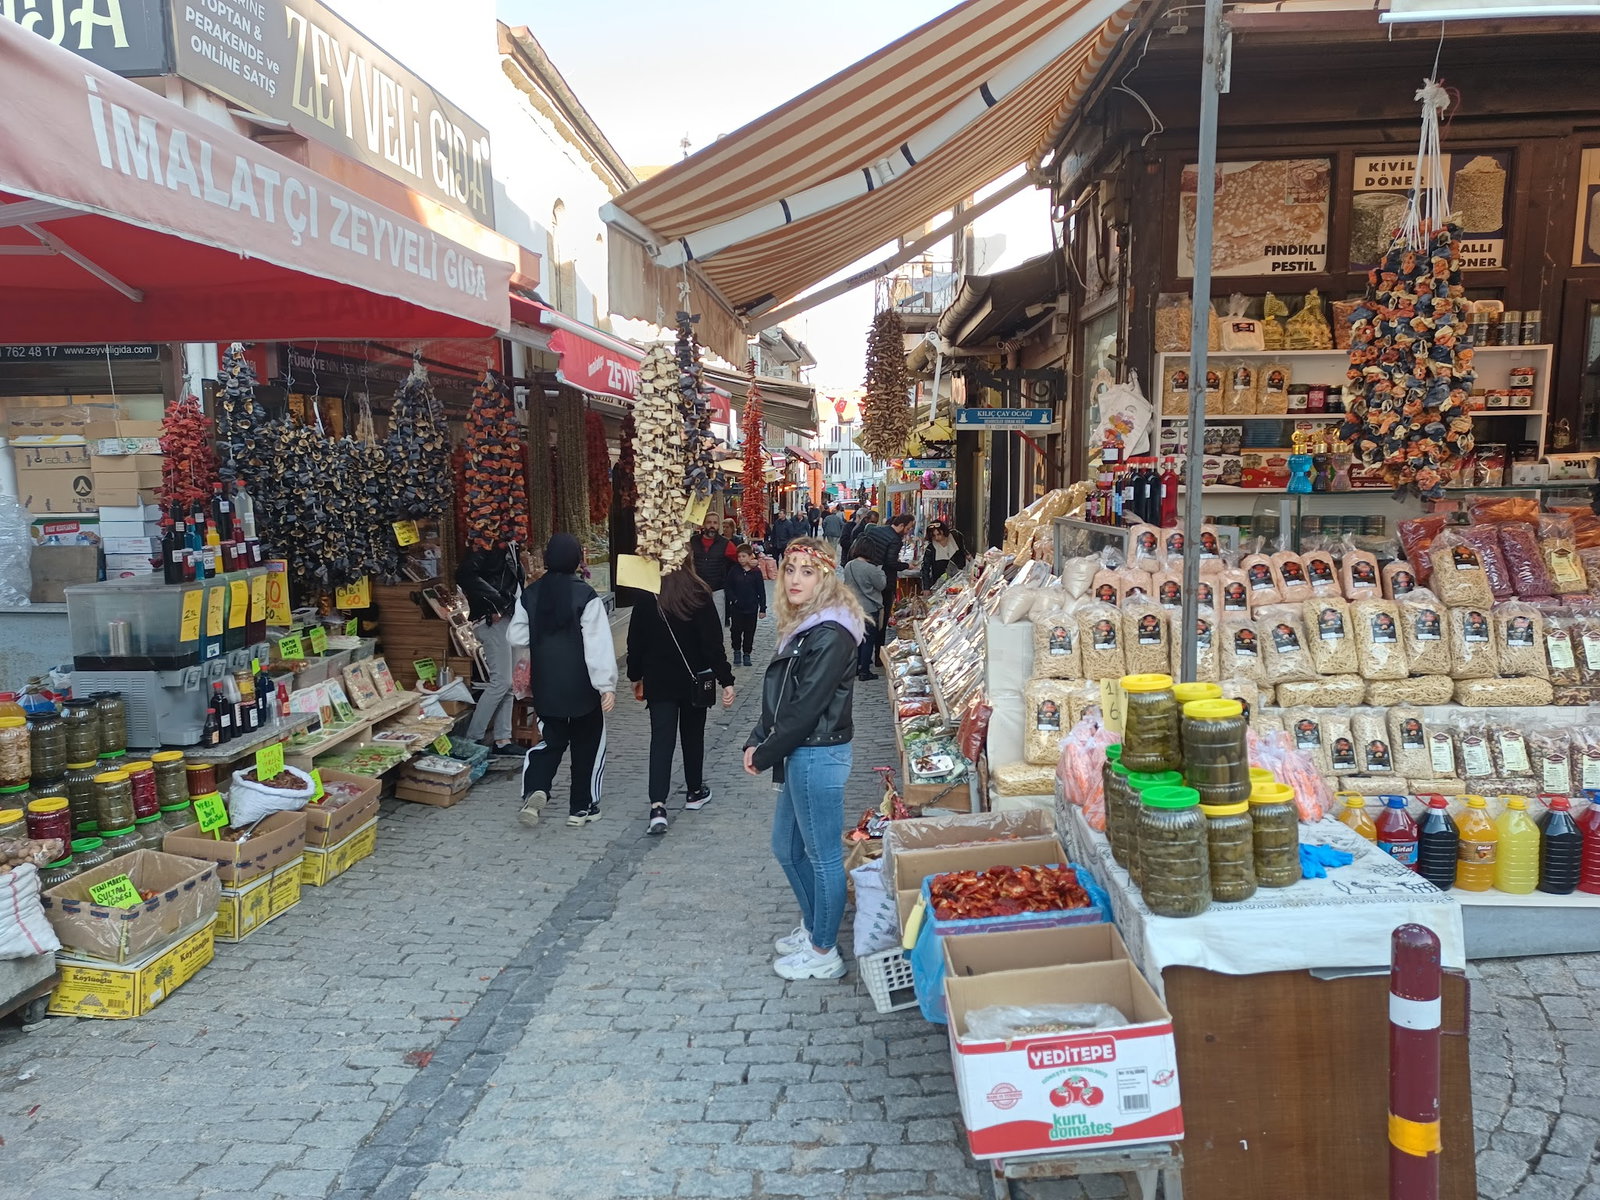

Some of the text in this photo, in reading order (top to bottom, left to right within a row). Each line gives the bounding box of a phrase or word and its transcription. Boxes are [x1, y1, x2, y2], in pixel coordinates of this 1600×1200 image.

[185, 5, 280, 74] PERAKENDE ve
[253, 25, 262, 41] &
[190, 34, 276, 98] ONLİNE SATIŞ
[429, 109, 487, 215] GIDA
[1368, 159, 1416, 172] KİVİL
[86, 74, 488, 301] İMALATÇI ZEYVELİ GIDA
[1365, 174, 1425, 187] DÖNER
[1264, 243, 1326, 257] FINDIKLI
[1459, 243, 1493, 253] ALLI
[1271, 257, 1317, 272] PESTİL
[1458, 255, 1498, 267] ÖNER
[6, 345, 152, 357] 762 48 17 www.zeyveligida.com
[977, 409, 1033, 420] KILIÇ ÇAY OCAĞI
[97, 883, 127, 904] SULTAN
[1030, 1044, 1114, 1067] YEDİTEPE
[1053, 1113, 1087, 1127] kuru
[1050, 1120, 1113, 1140] domates
